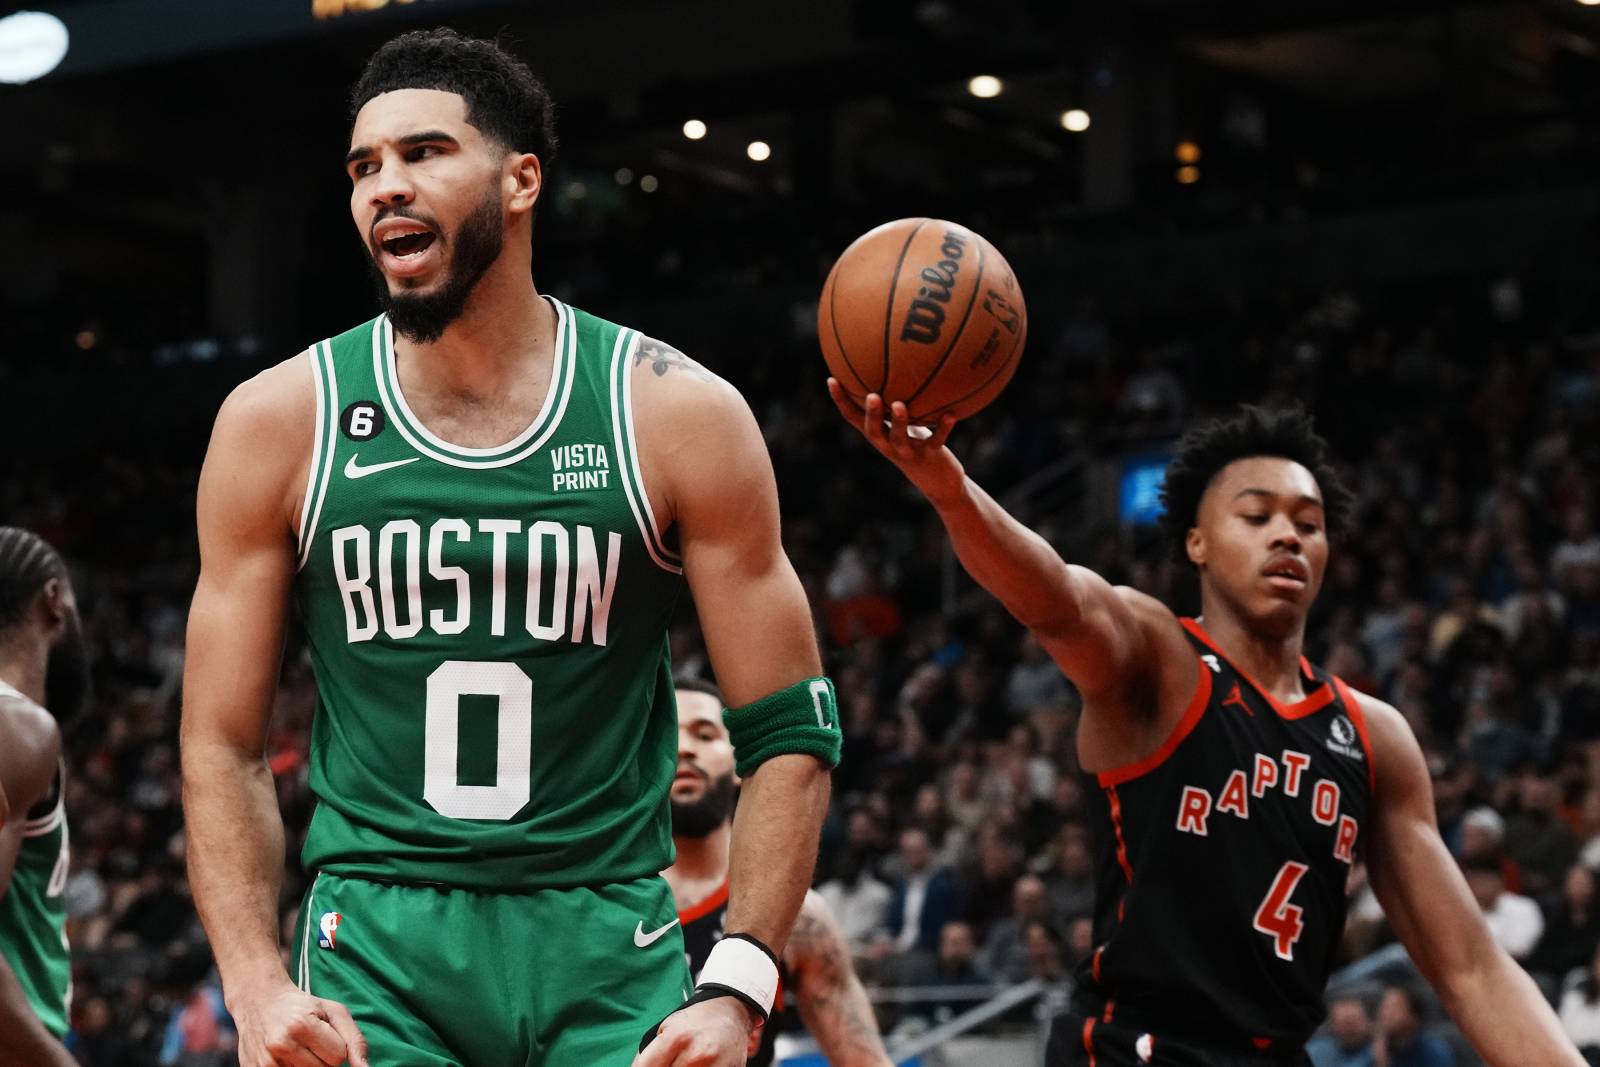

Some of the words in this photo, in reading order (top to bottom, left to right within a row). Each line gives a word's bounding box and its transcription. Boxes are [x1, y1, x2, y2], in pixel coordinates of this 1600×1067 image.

[900, 231, 968, 345] Wilson
[350, 406, 375, 437] 6
[550, 444, 609, 472] VISTA
[552, 470, 610, 492] PRINT
[331, 518, 622, 646] BOSTON
[1253, 860, 1309, 962] 4
